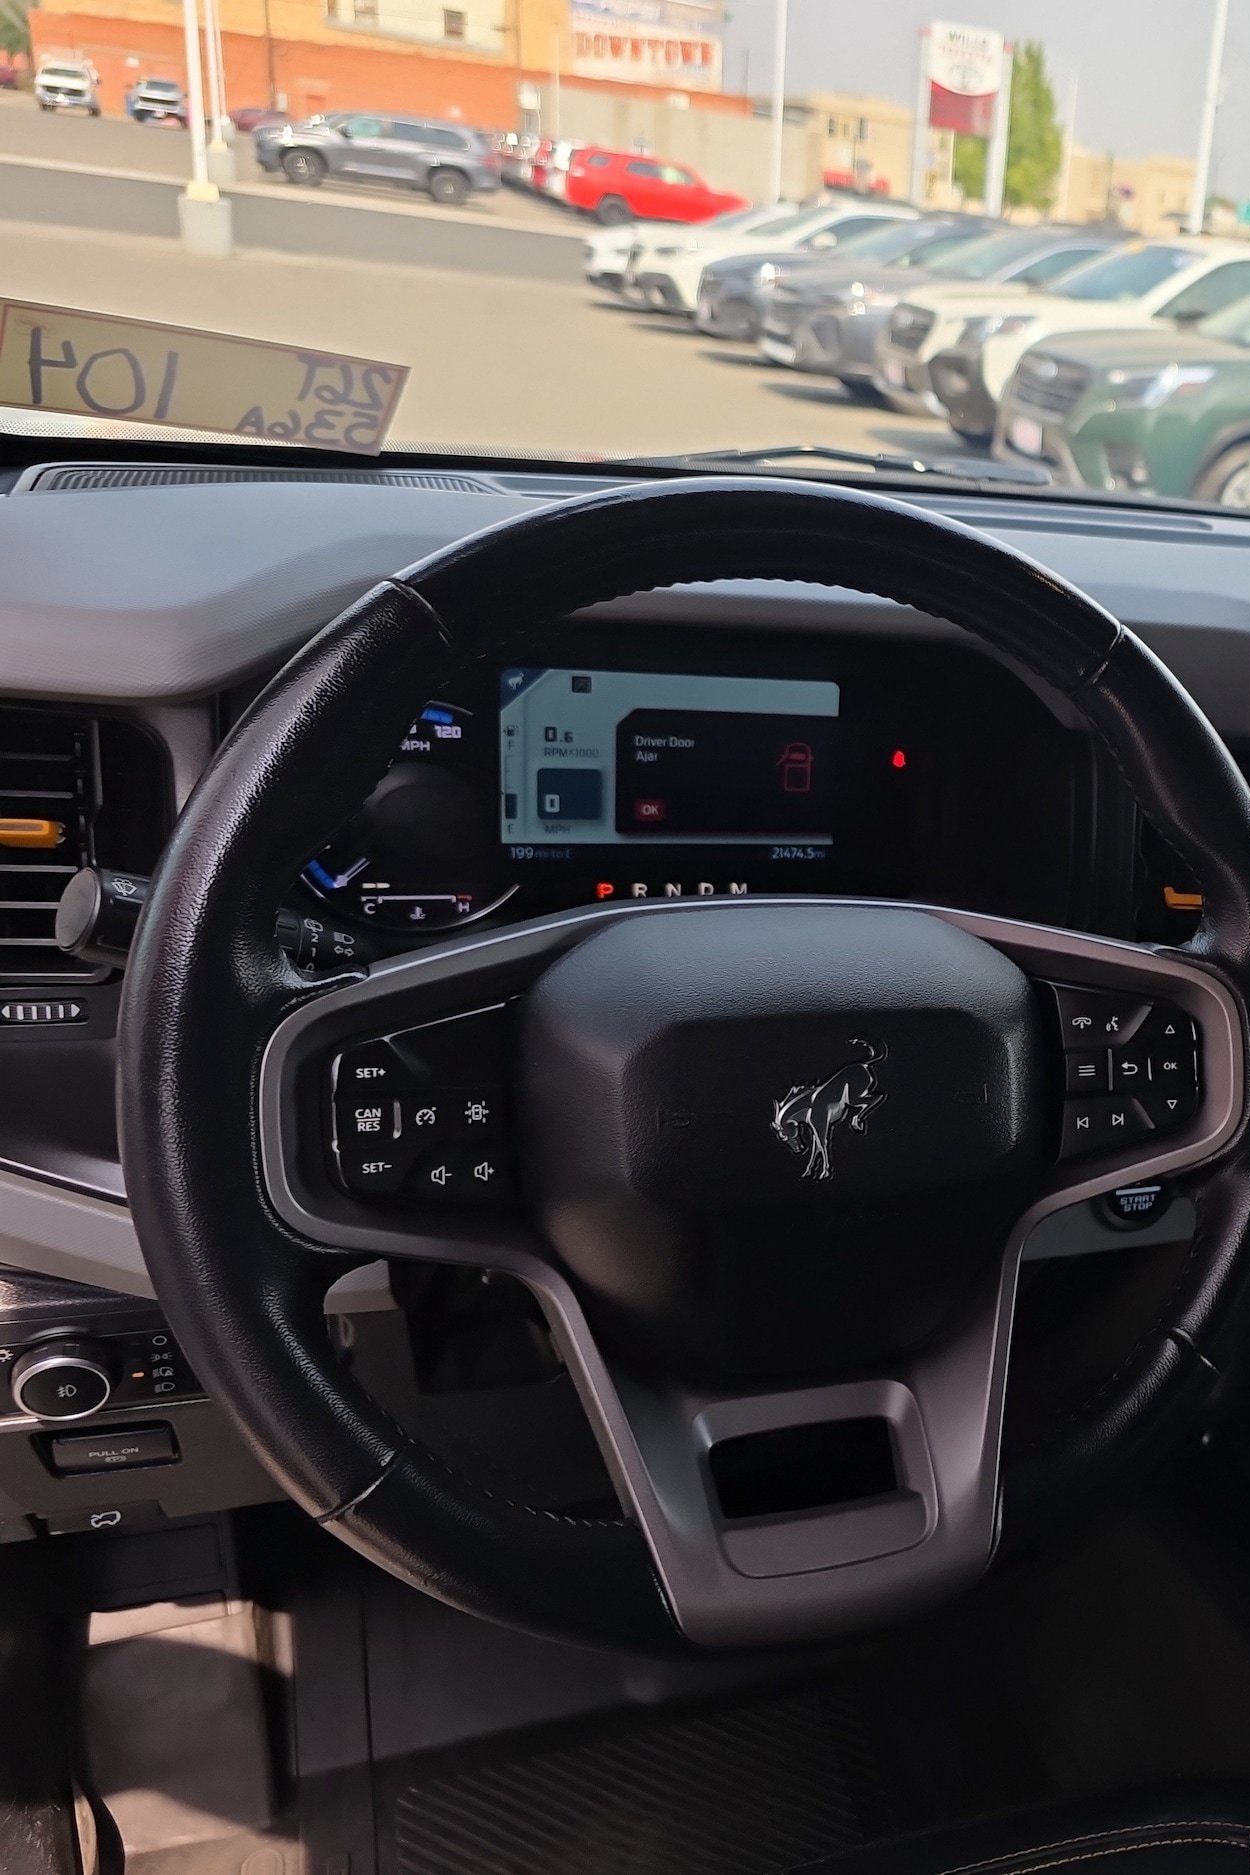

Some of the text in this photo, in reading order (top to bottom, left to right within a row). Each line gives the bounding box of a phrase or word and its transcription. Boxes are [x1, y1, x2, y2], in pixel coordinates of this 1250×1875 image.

[433, 724, 462, 739] 120
[544, 725, 575, 743] 0.6
[400, 738, 432, 752] MPH
[634, 734, 696, 749] Driver Door
[635, 750, 659, 764] Ajar
[641, 803, 660, 817] OK
[511, 846, 535, 860] 199
[596, 880, 615, 899] P
[632, 881, 649, 898] R
[666, 881, 683, 898] N
[700, 881, 715, 898] D
[731, 881, 749, 897] M
[363, 902, 377, 915] C
[457, 902, 471, 913] H
[355, 1067, 387, 1079] SET+
[1162, 1061, 1178, 1071] OK
[354, 1107, 383, 1119] CAN
[356, 1120, 381, 1132] RES
[1120, 1194, 1155, 1205] START
[1123, 1202, 1153, 1212] STOP
